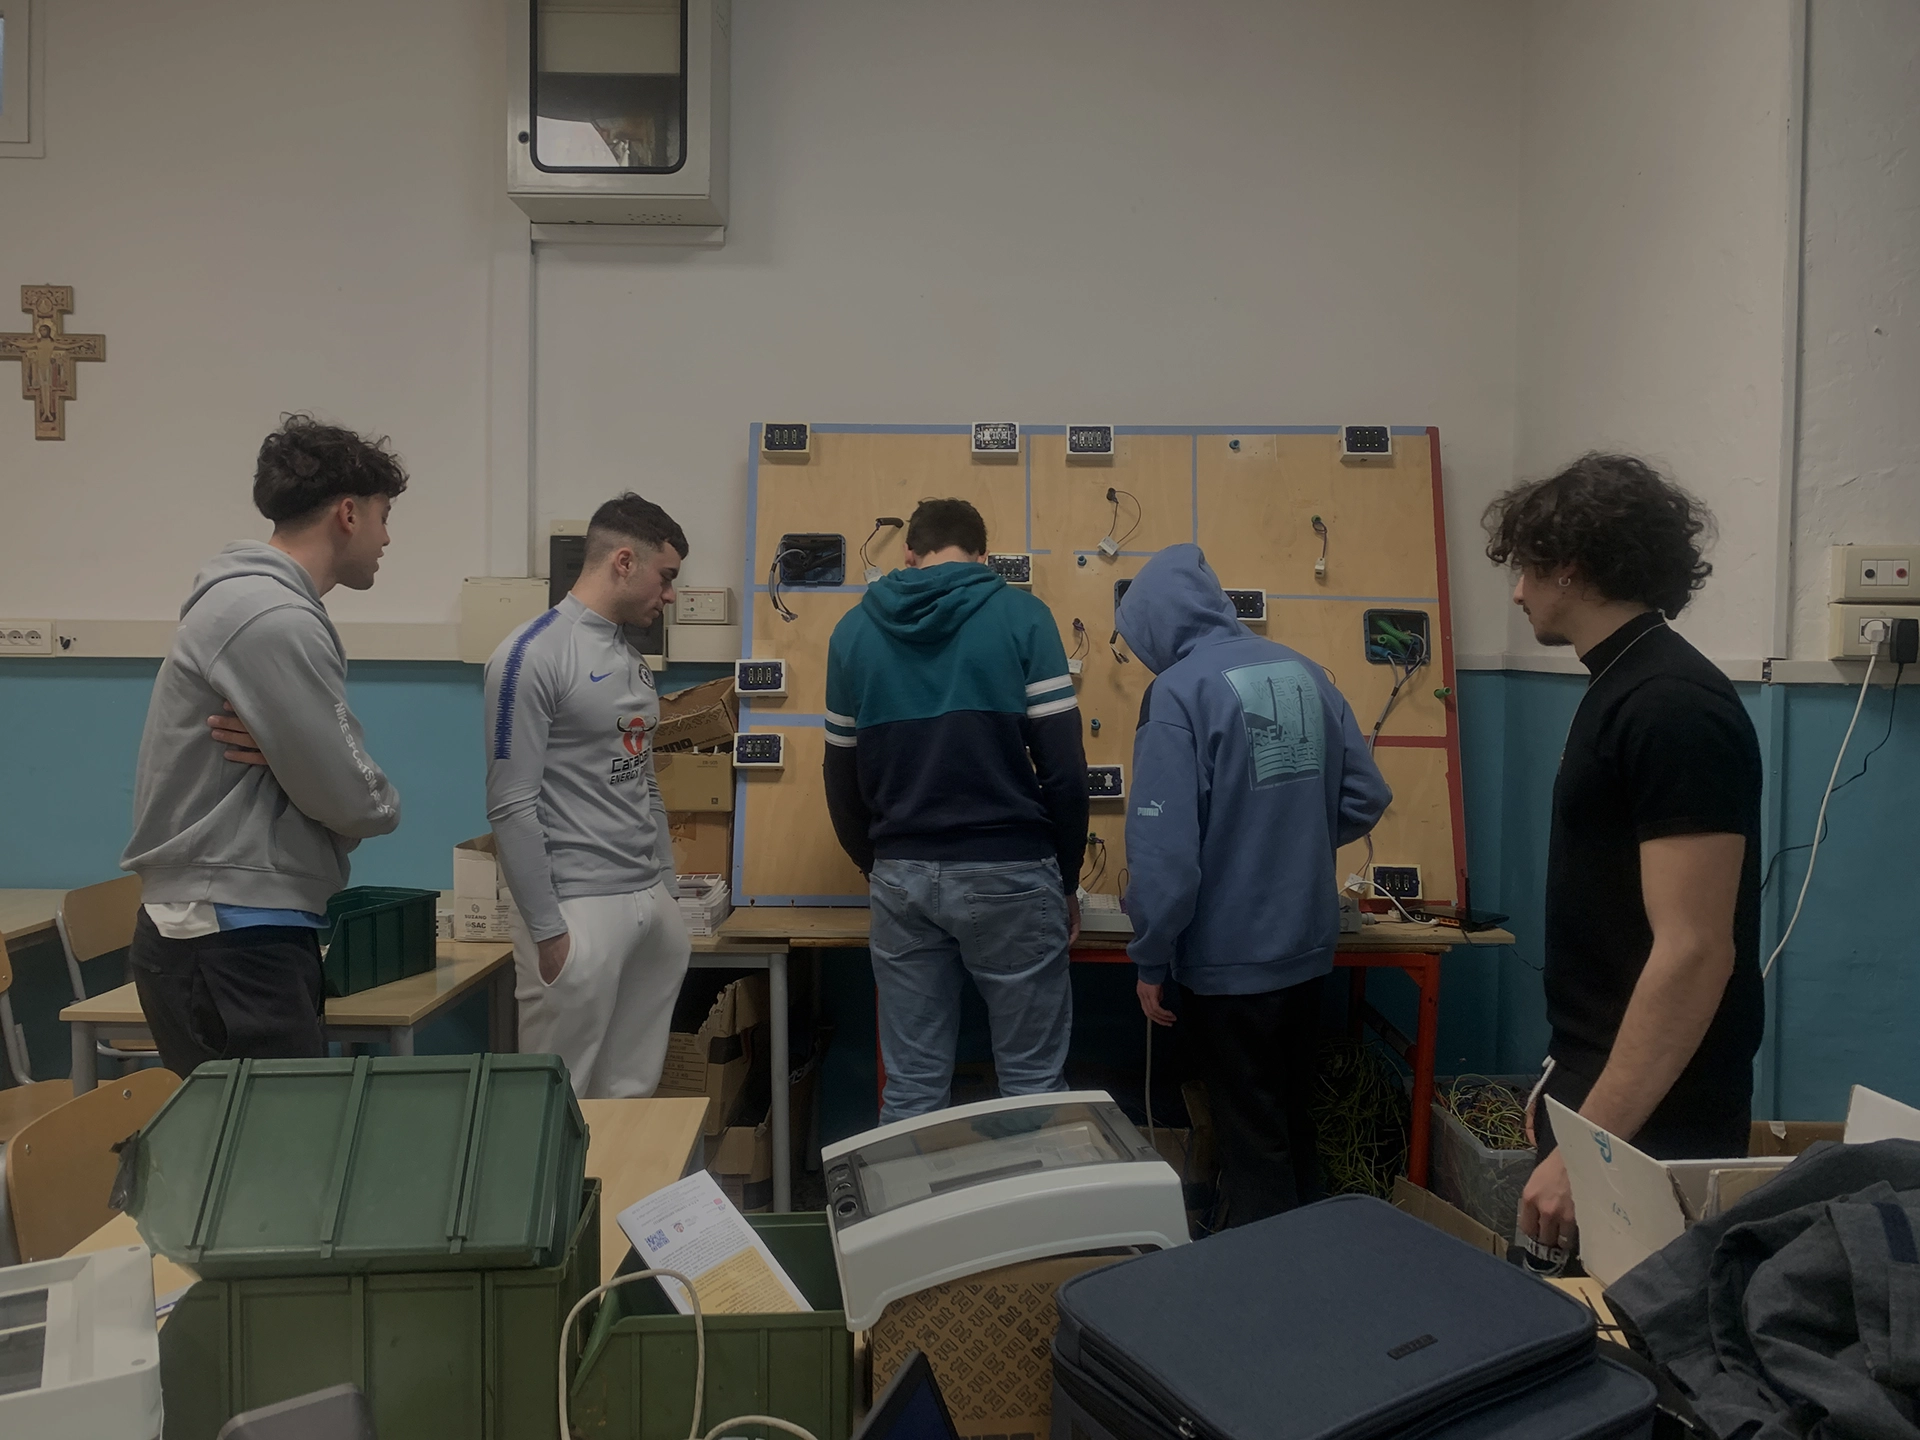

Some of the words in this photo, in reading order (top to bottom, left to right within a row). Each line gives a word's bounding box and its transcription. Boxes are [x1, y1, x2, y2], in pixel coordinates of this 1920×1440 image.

[1277, 697, 1315, 718] NOT
[334, 702, 350, 734] NIKE
[610, 769, 639, 785] ENERGY
[1137, 806, 1160, 817] PUMA
